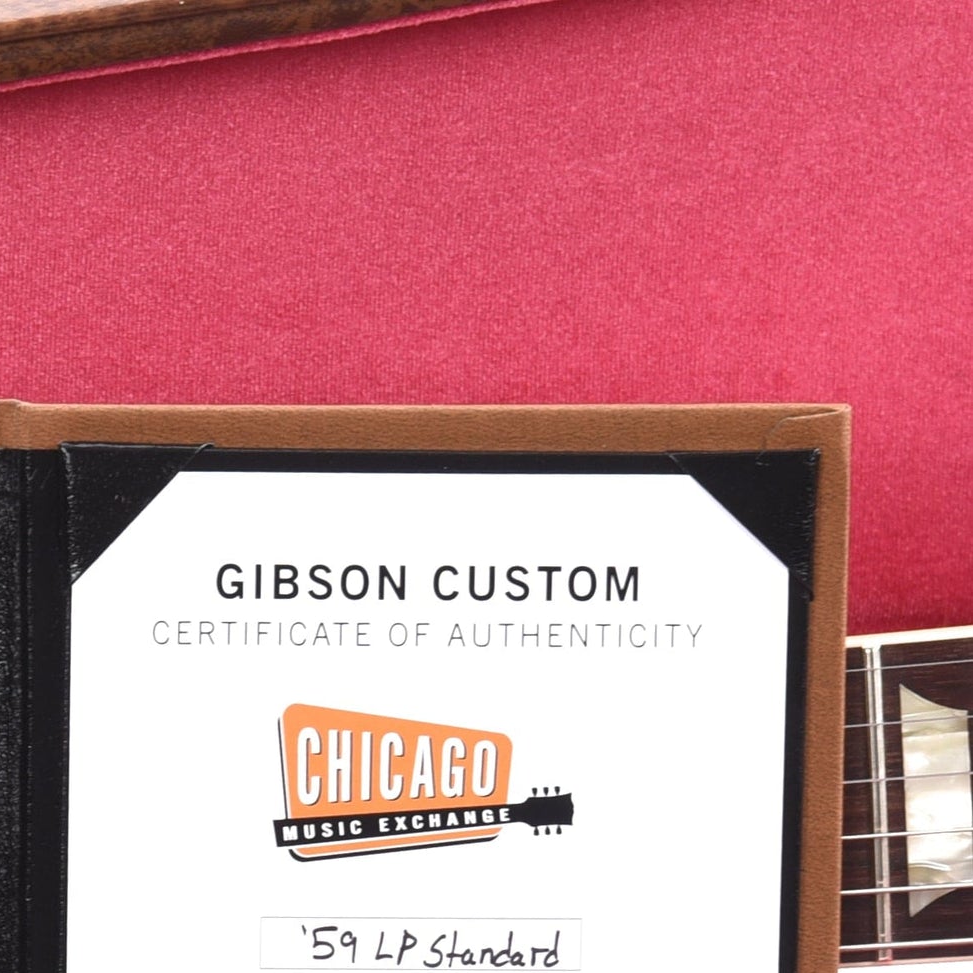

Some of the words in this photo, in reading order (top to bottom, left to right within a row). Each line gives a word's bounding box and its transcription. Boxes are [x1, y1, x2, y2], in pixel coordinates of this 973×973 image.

[216, 563, 406, 601] GIBSON
[433, 565, 639, 602] CUSTOM
[153, 620, 371, 646] CERTIFICATE
[389, 623, 430, 647] OF
[448, 623, 702, 648] AUTHENTICITY
[296, 726, 499, 806] CHICAGO
[282, 820, 364, 842] MUSIC
[379, 807, 511, 833] EXCHANGE
[375, 929, 418, 965] LP
[423, 930, 560, 968] Standard
